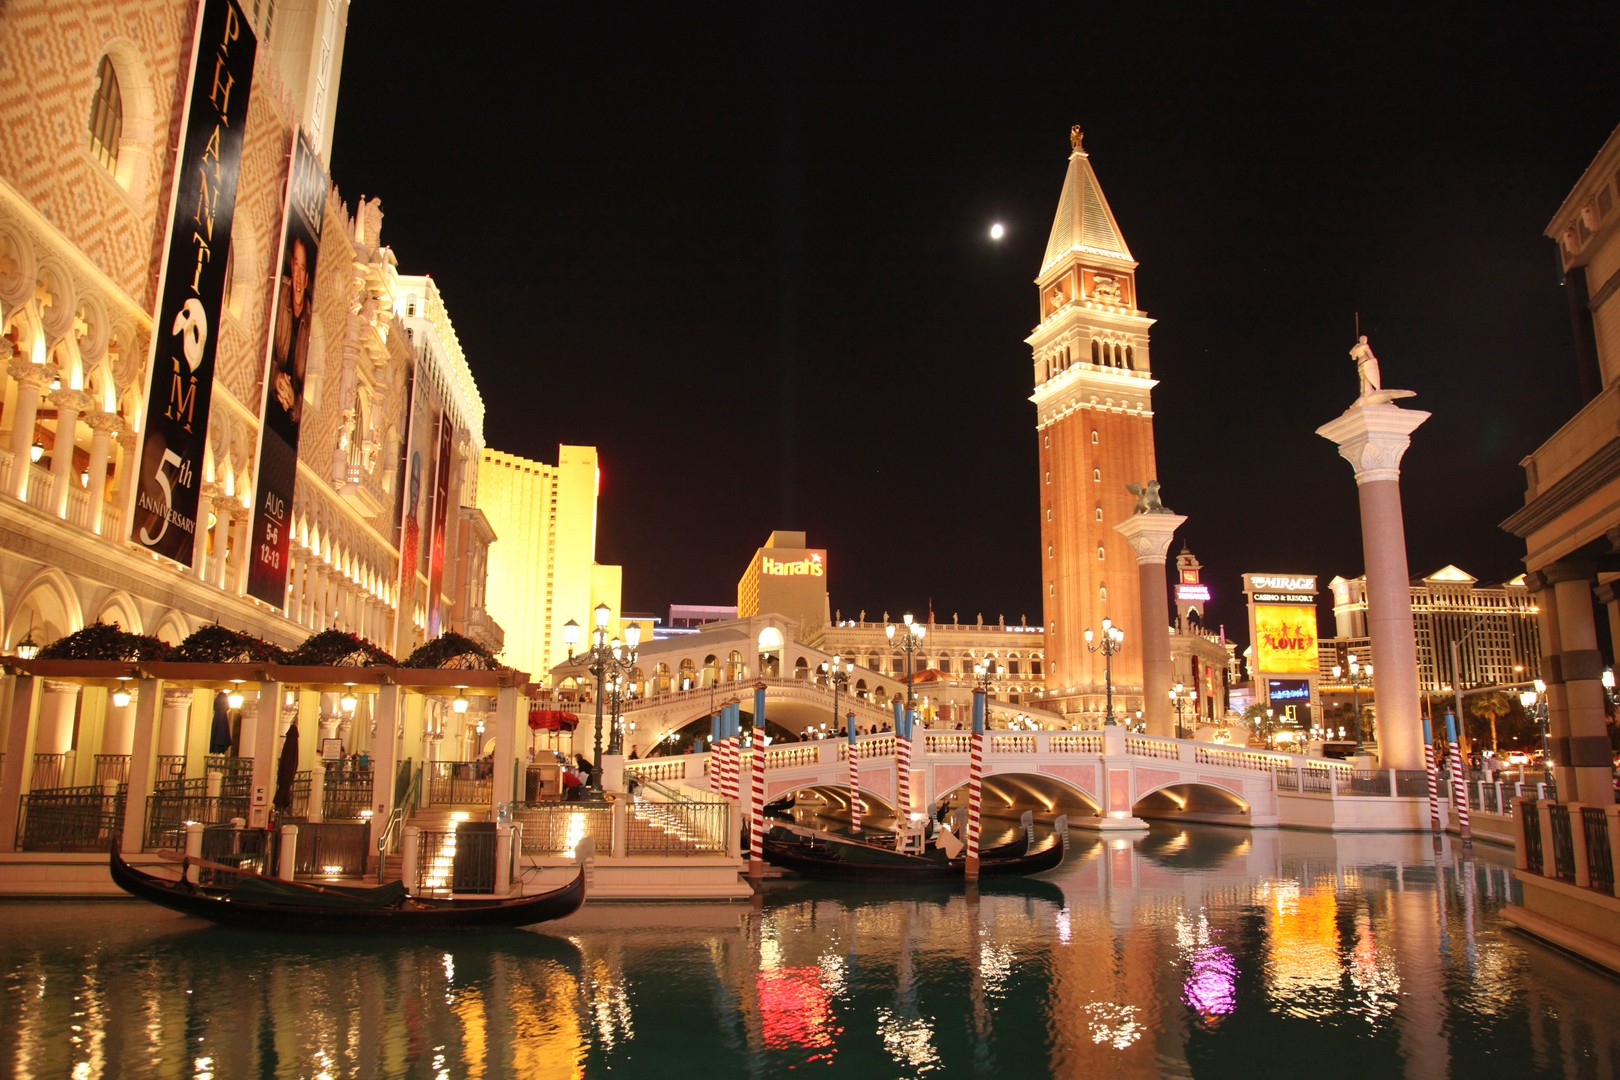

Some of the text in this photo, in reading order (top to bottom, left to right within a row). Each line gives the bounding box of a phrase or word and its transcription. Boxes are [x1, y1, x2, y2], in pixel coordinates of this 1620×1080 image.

[300, 138, 325, 210] TIM
[293, 176, 321, 234] ALLEN
[140, 447, 193, 546] 5th
[264, 491, 284, 520] AUG
[138, 491, 196, 534] ANNIVERSARY
[266, 522, 279, 546] 5-6
[261, 543, 280, 570] 12-13
[1256, 577, 1314, 590] MIRAGE
[1272, 637, 1305, 650] LOVE
